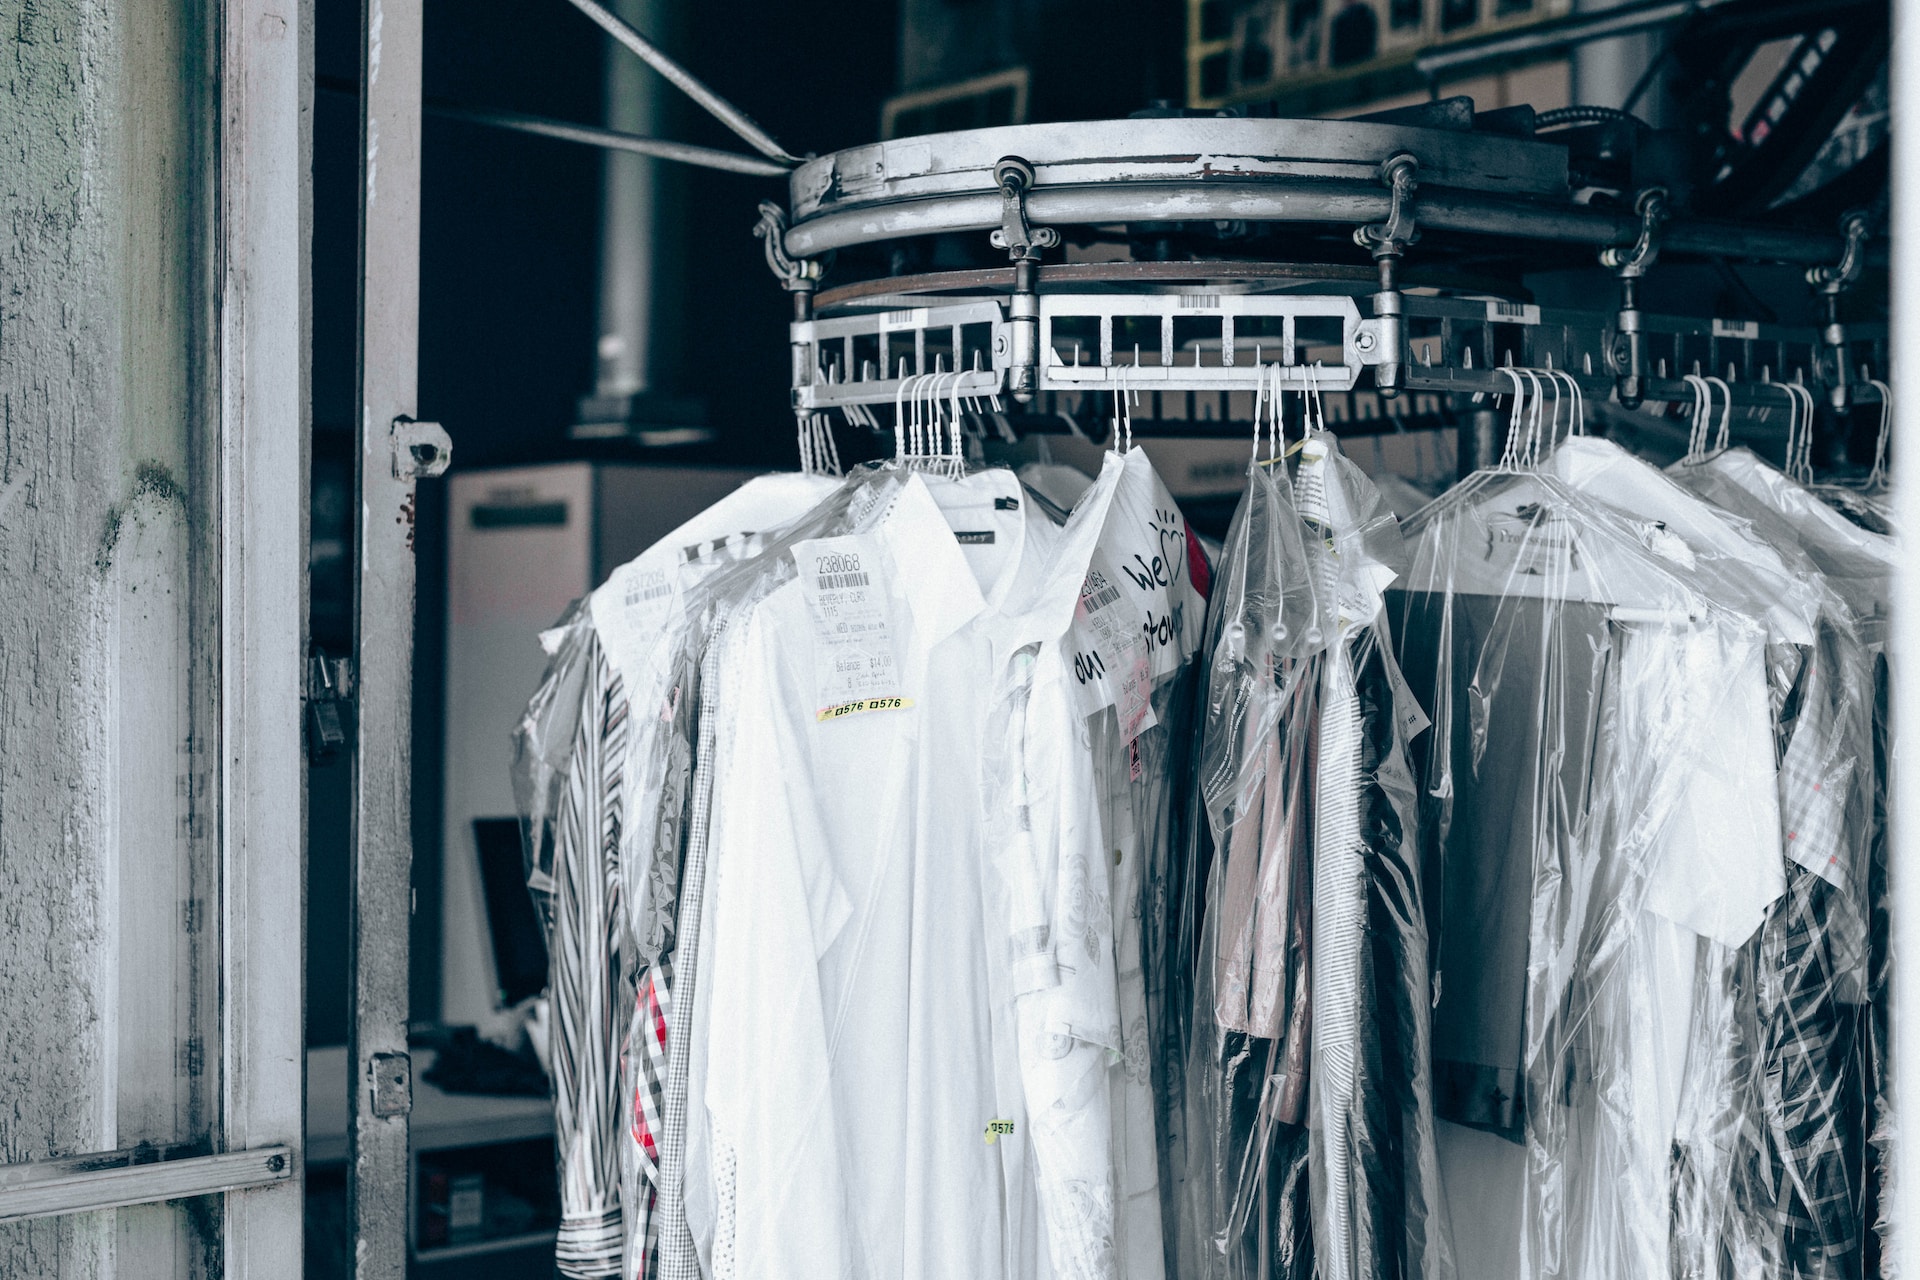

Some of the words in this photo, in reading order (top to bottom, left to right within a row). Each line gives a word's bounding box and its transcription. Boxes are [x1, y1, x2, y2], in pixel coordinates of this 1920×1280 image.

[816, 553, 860, 574] 238068
[1122, 554, 1168, 591] We
[823, 606, 839, 618] 1115
[836, 660, 861, 673] Balance
[879, 698, 901, 708] 576
